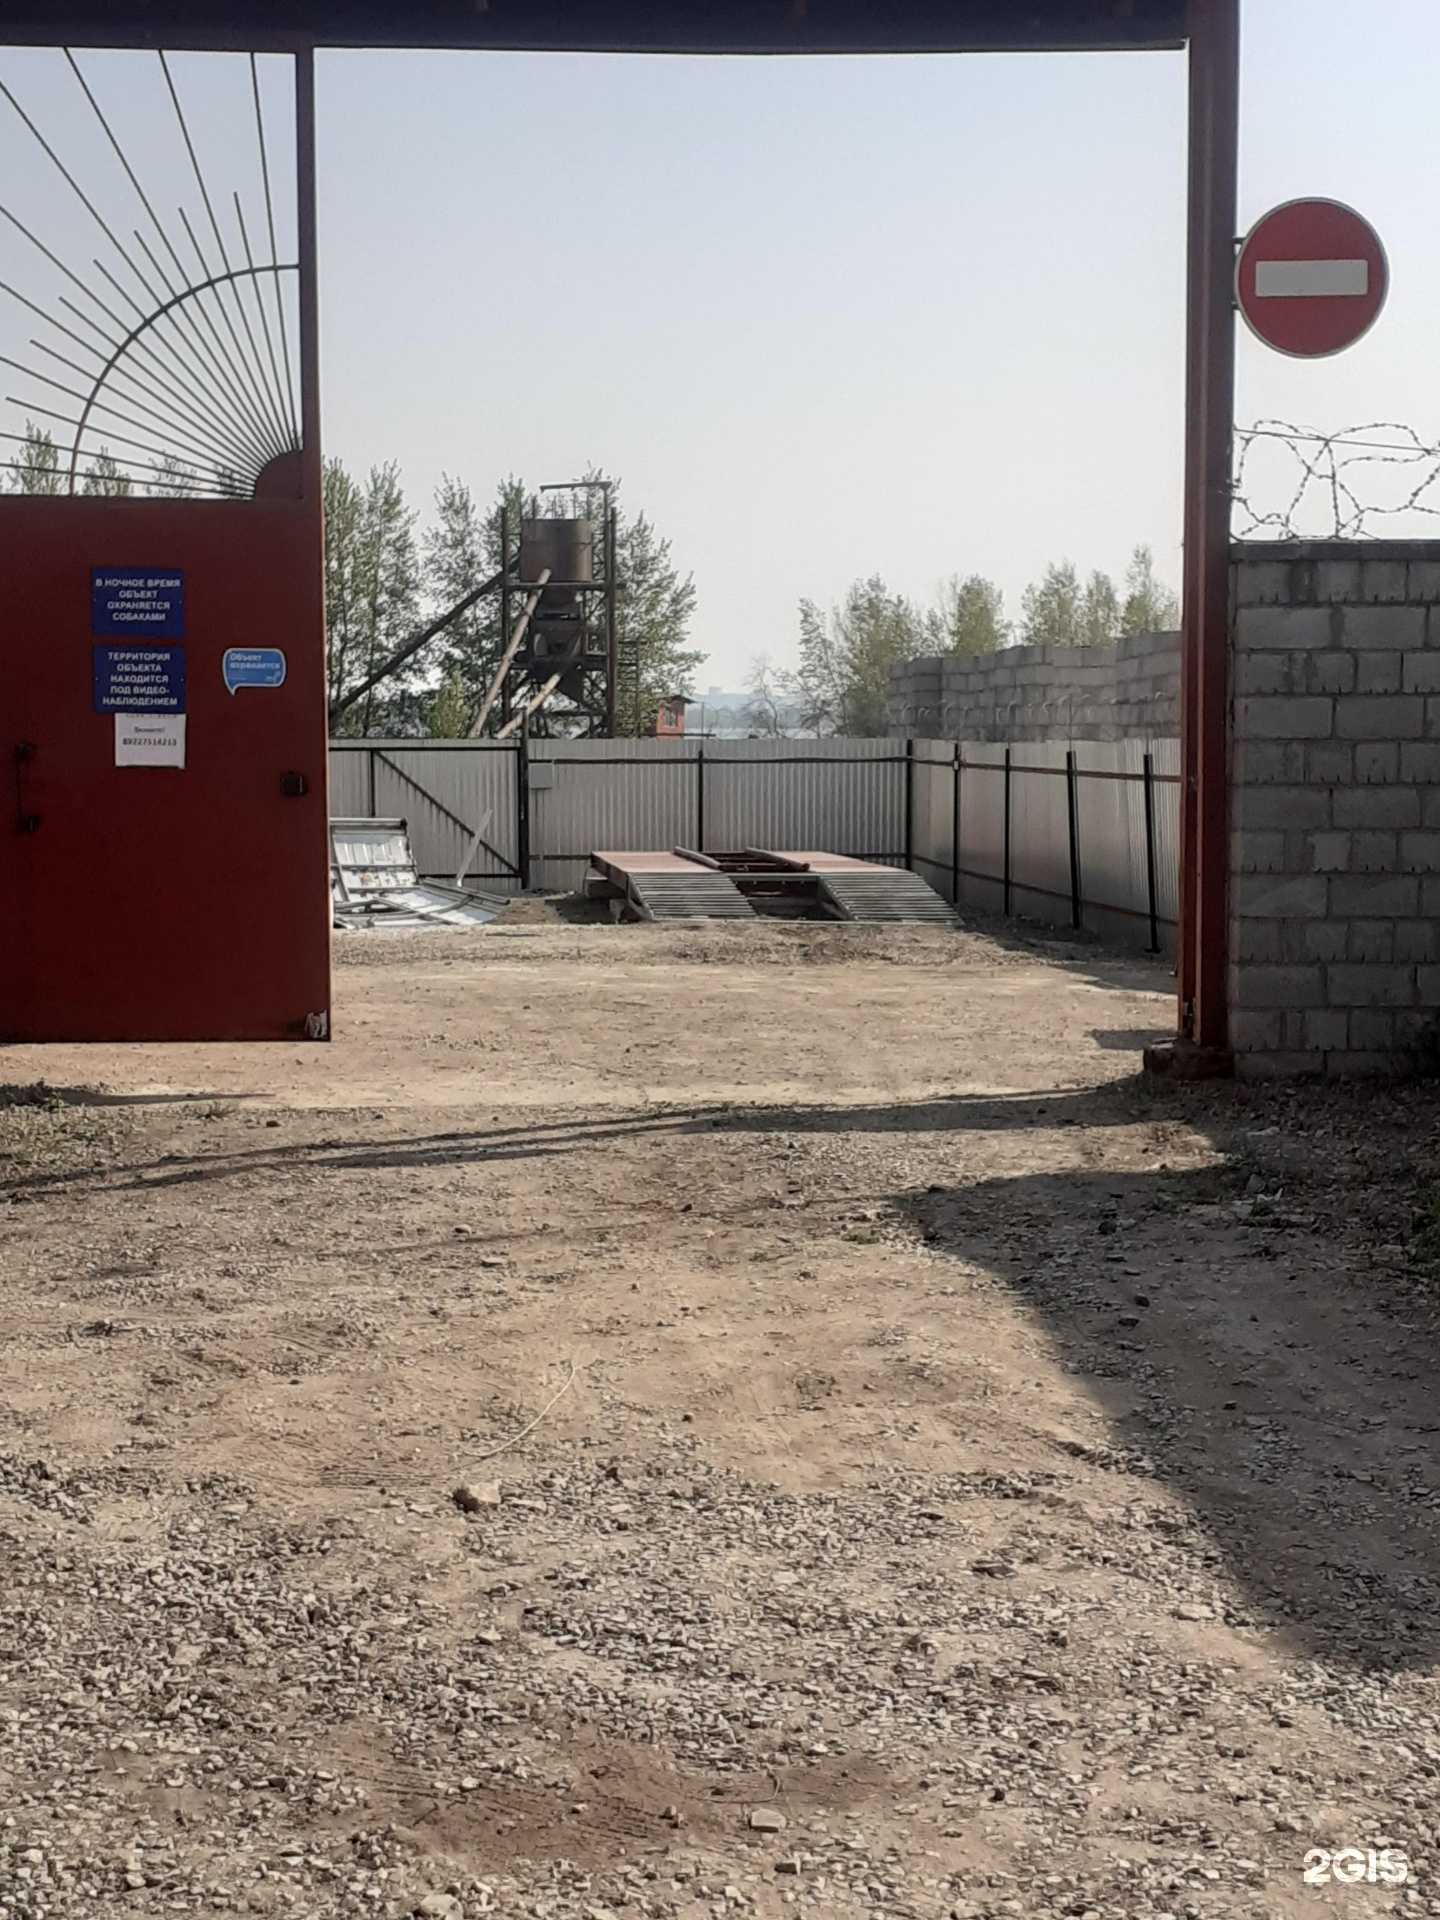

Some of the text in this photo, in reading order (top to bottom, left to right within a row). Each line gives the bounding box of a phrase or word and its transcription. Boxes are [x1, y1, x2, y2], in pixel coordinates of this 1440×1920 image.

[95, 579, 181, 587] В НОЧНОЕ ВРЕМЯ
[119, 590, 158, 599] ОБЪЕКТ
[107, 601, 170, 610] ОХРАНЯЕТСЯ
[112, 612, 166, 621] СОБАКАМИ
[108, 652, 170, 661] ТЕРРИТОРИЯ
[117, 663, 162, 672] ОБЪЕКТА
[110, 674, 169, 683] НАХОДИТСЯ
[110, 686, 170, 695] ПОД ВИДЕО-
[102, 697, 178, 706] НАБЛЮДЕНИЕМ
